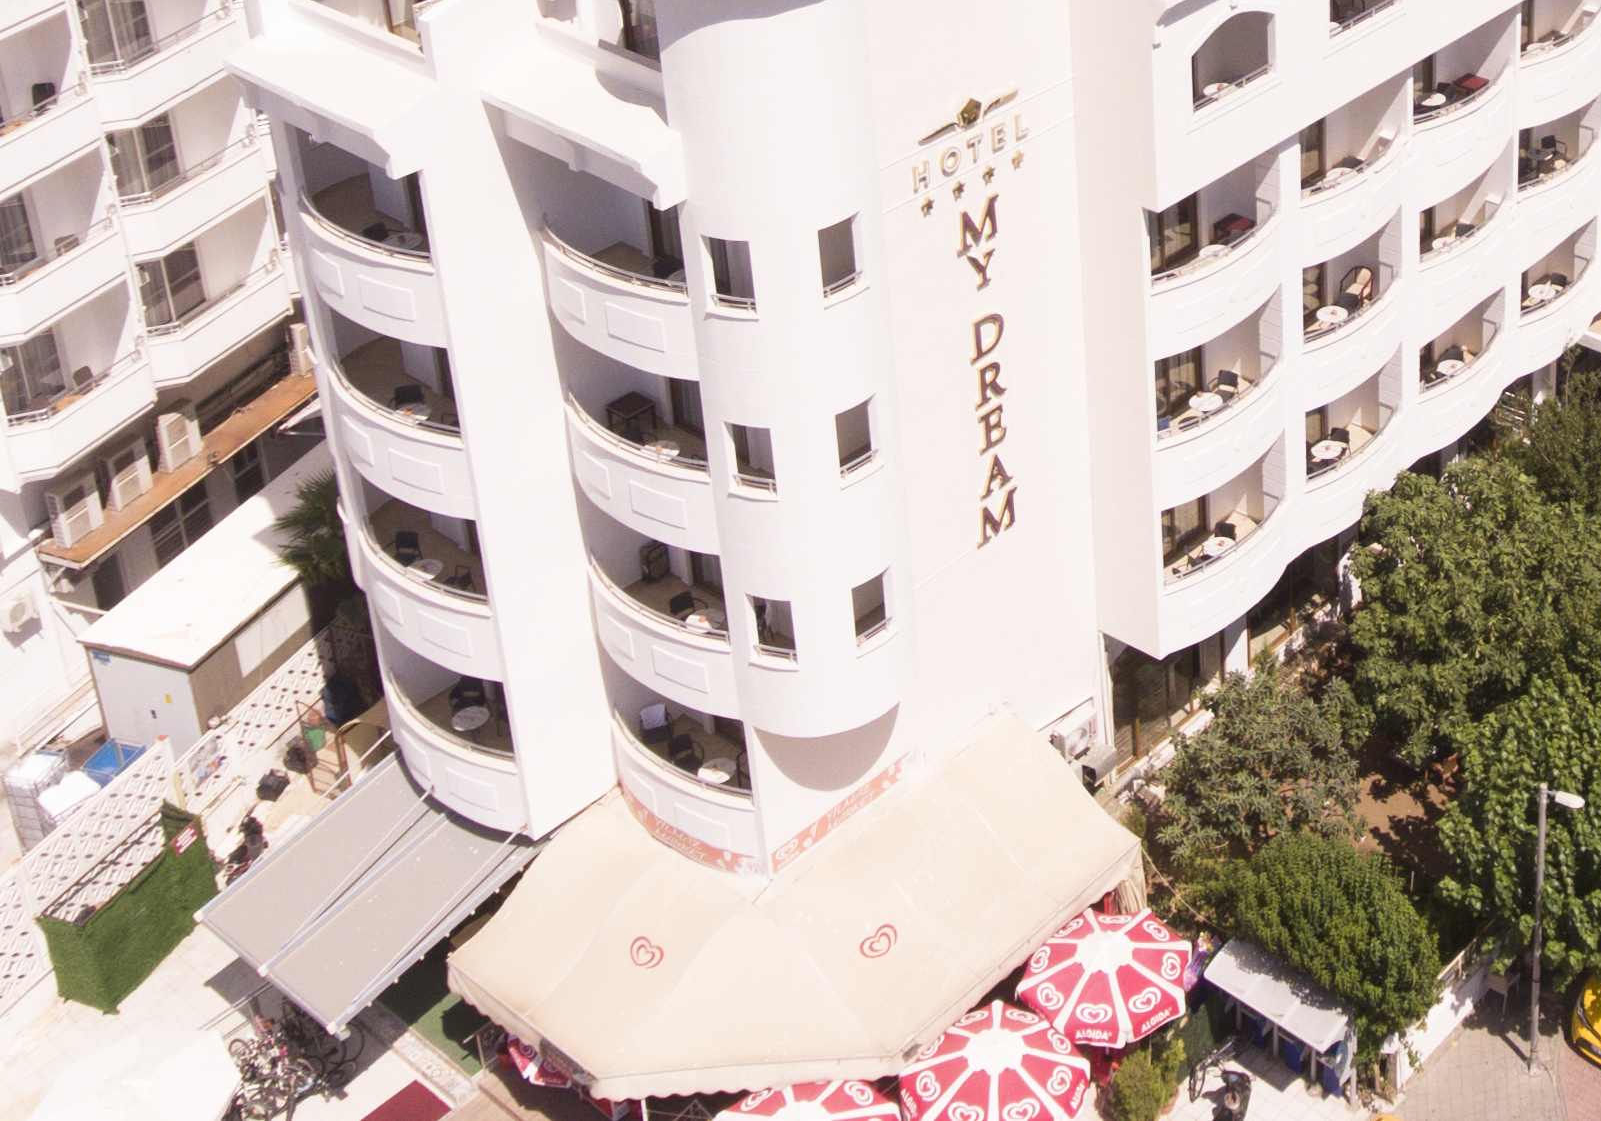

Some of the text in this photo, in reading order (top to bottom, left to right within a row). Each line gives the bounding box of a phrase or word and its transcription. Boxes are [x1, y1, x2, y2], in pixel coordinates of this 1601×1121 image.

[911, 114, 1030, 193] HOTEL
[956, 192, 1019, 549] MY DREAM
[1075, 1029, 1109, 1041] ALGIDA
[1141, 1009, 1171, 1033] ALGIDA
